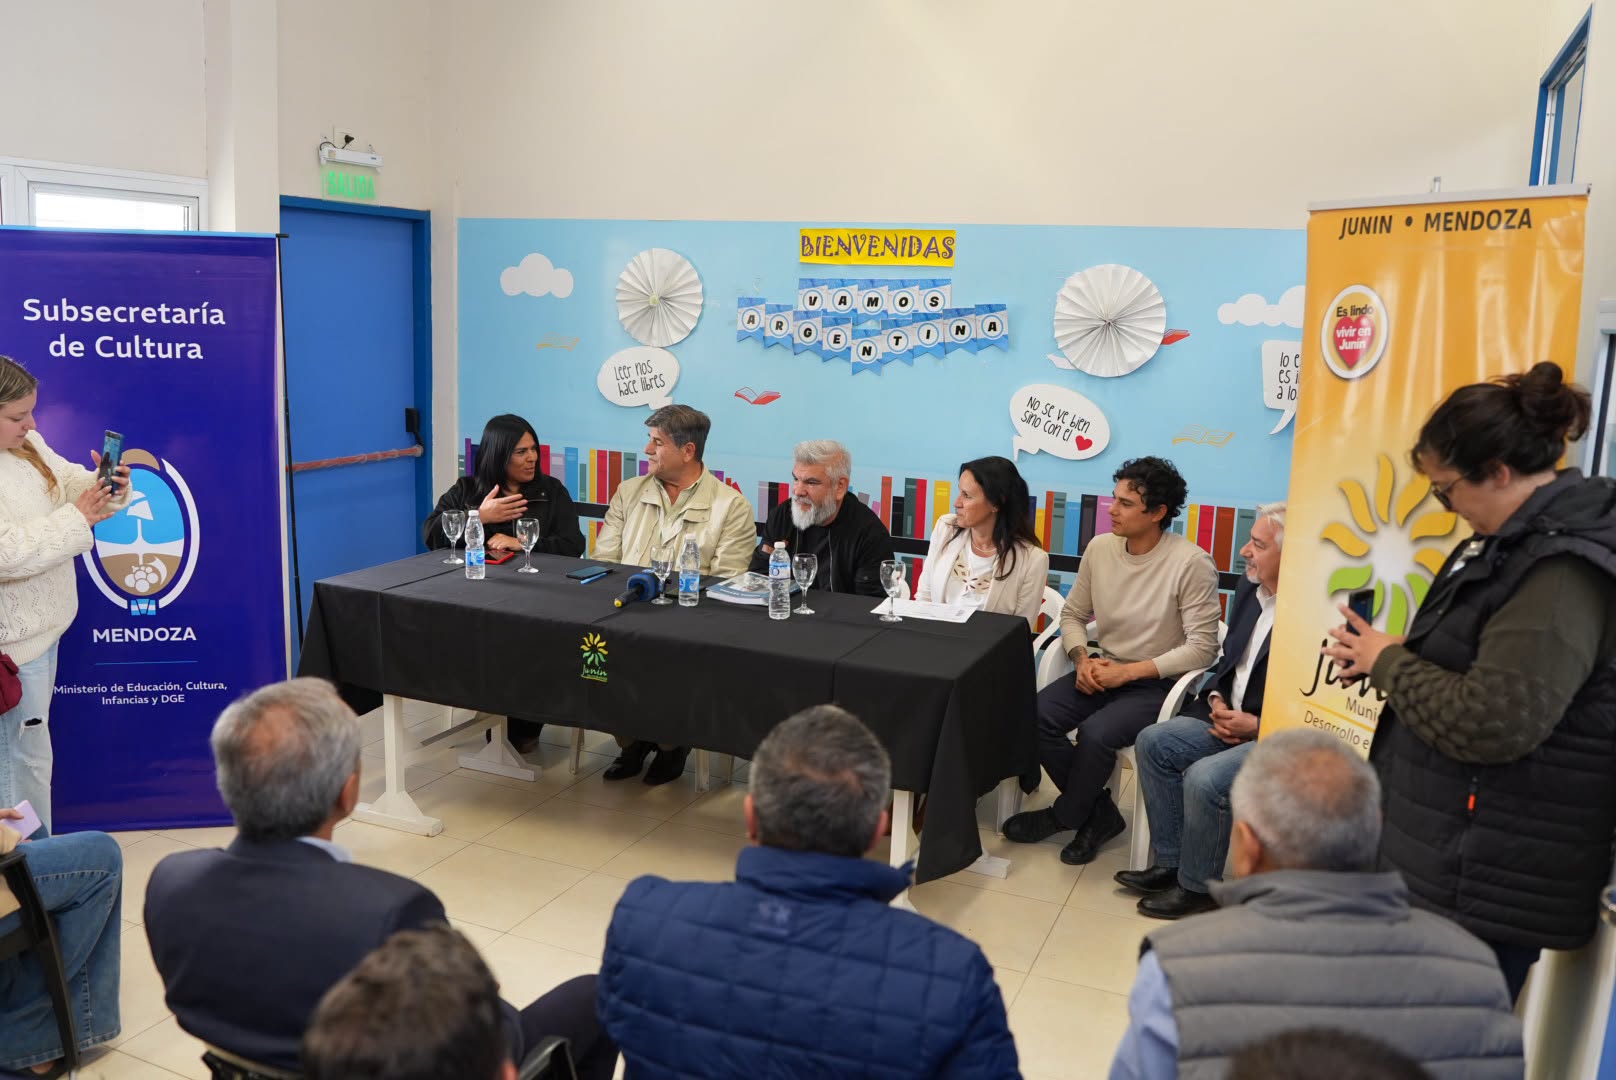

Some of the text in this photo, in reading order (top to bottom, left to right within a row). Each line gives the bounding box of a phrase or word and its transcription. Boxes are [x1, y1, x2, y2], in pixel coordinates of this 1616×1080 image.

[327, 170, 377, 200] SALIDA
[1339, 208, 1532, 240] JUNIN MENDOZA
[801, 232, 955, 260] BIENVENIDAS
[23, 298, 226, 325] Subsecretaría
[808, 294, 940, 308] VAMOS
[1336, 304, 1374, 317] Es lindo
[746, 311, 998, 358] ARGENTINA
[1336, 325, 1372, 338] vivir en
[49, 333, 204, 360] de Cultura
[614, 360, 653, 381] Leer nos
[618, 373, 665, 396] hace libres
[1287, 385, 1297, 401] lo
[1026, 396, 1091, 434] No se ve bien
[1063, 427, 1073, 442] el
[93, 626, 197, 643] MENDOZA
[54, 680, 228, 695] Ministerio de Educación, Cultura,
[102, 693, 186, 706] Infancias y DGE
